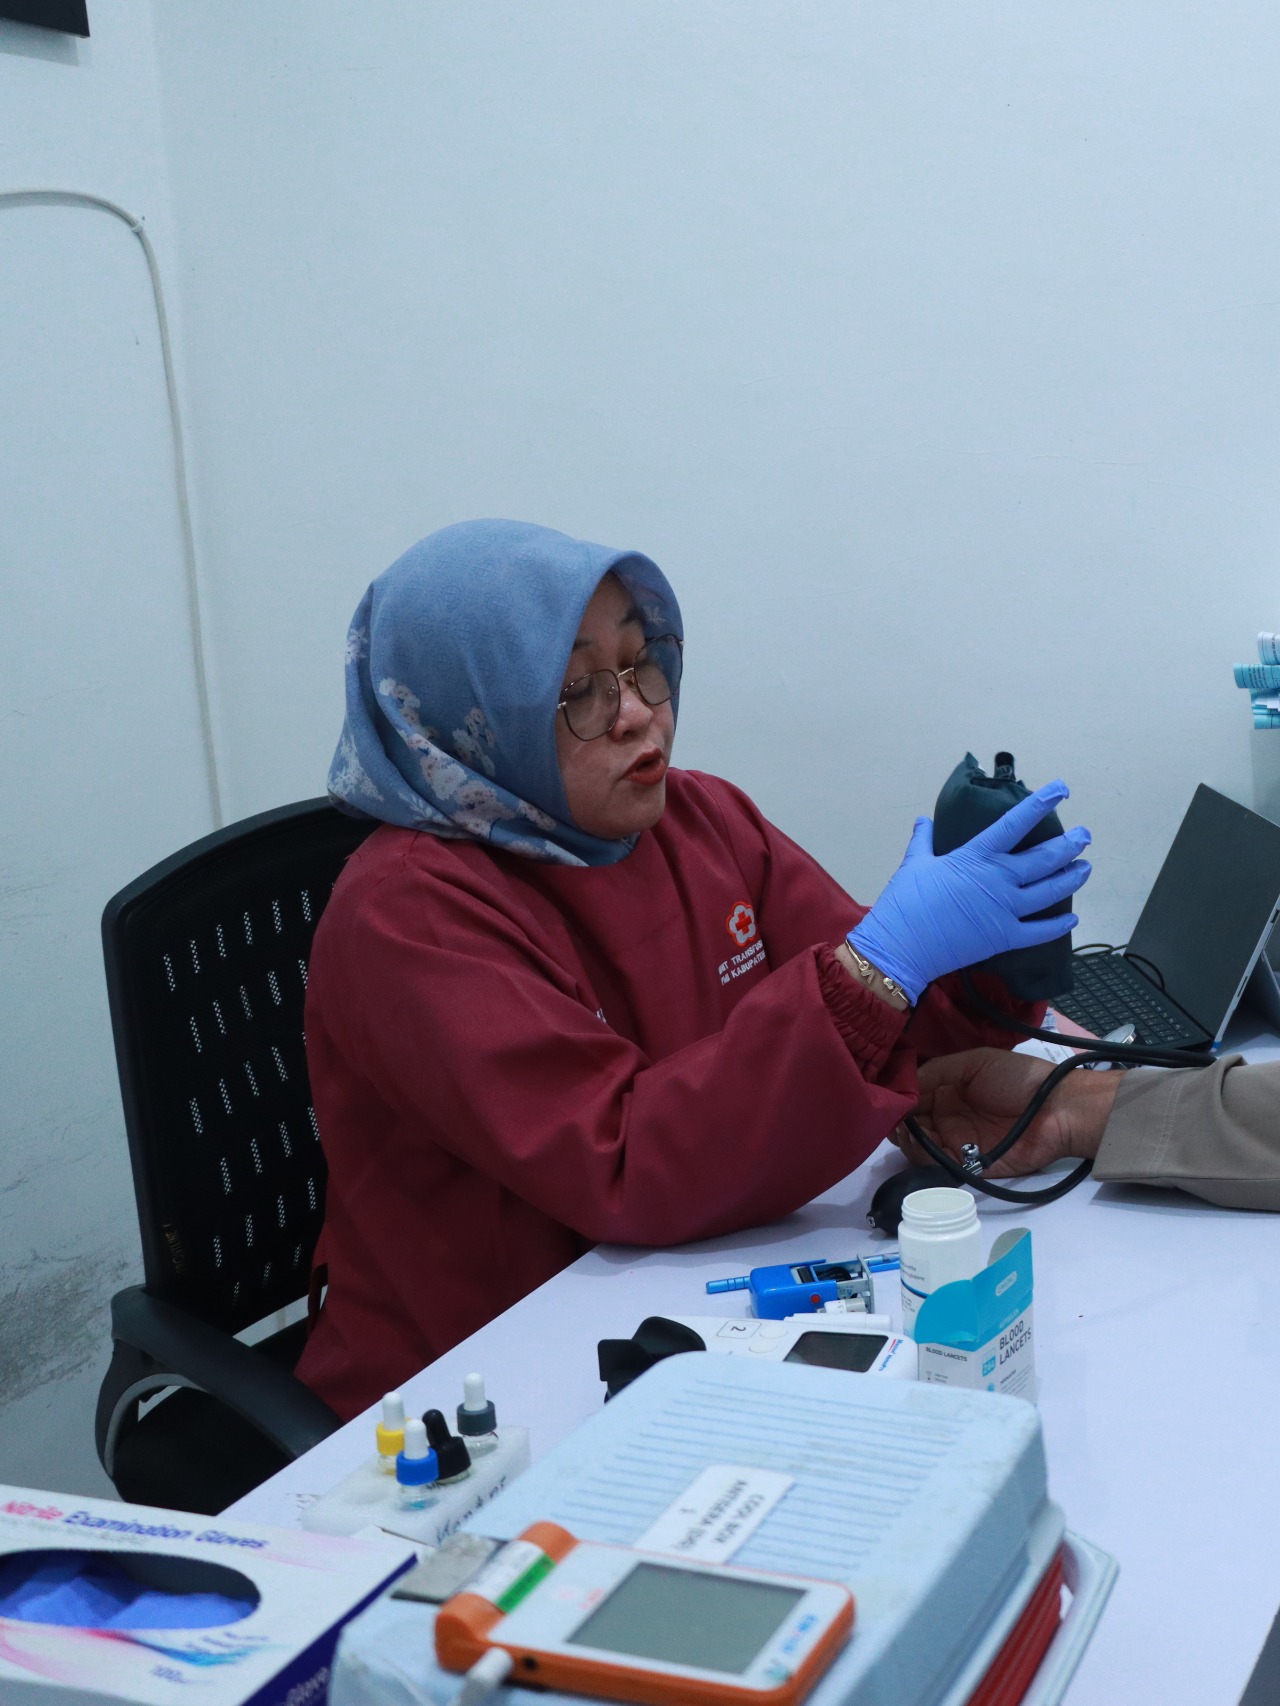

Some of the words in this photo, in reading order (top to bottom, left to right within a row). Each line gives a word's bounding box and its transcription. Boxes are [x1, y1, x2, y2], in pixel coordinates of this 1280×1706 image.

[999, 1320, 1024, 1350] BLOOD
[999, 1327, 1032, 1366] LANCETS
[925, 1346, 943, 1356] BLOOD
[943, 1351, 968, 1362] LANCETS
[64, 1510, 193, 1539] Examination
[195, 1530, 269, 1550] Gloves
